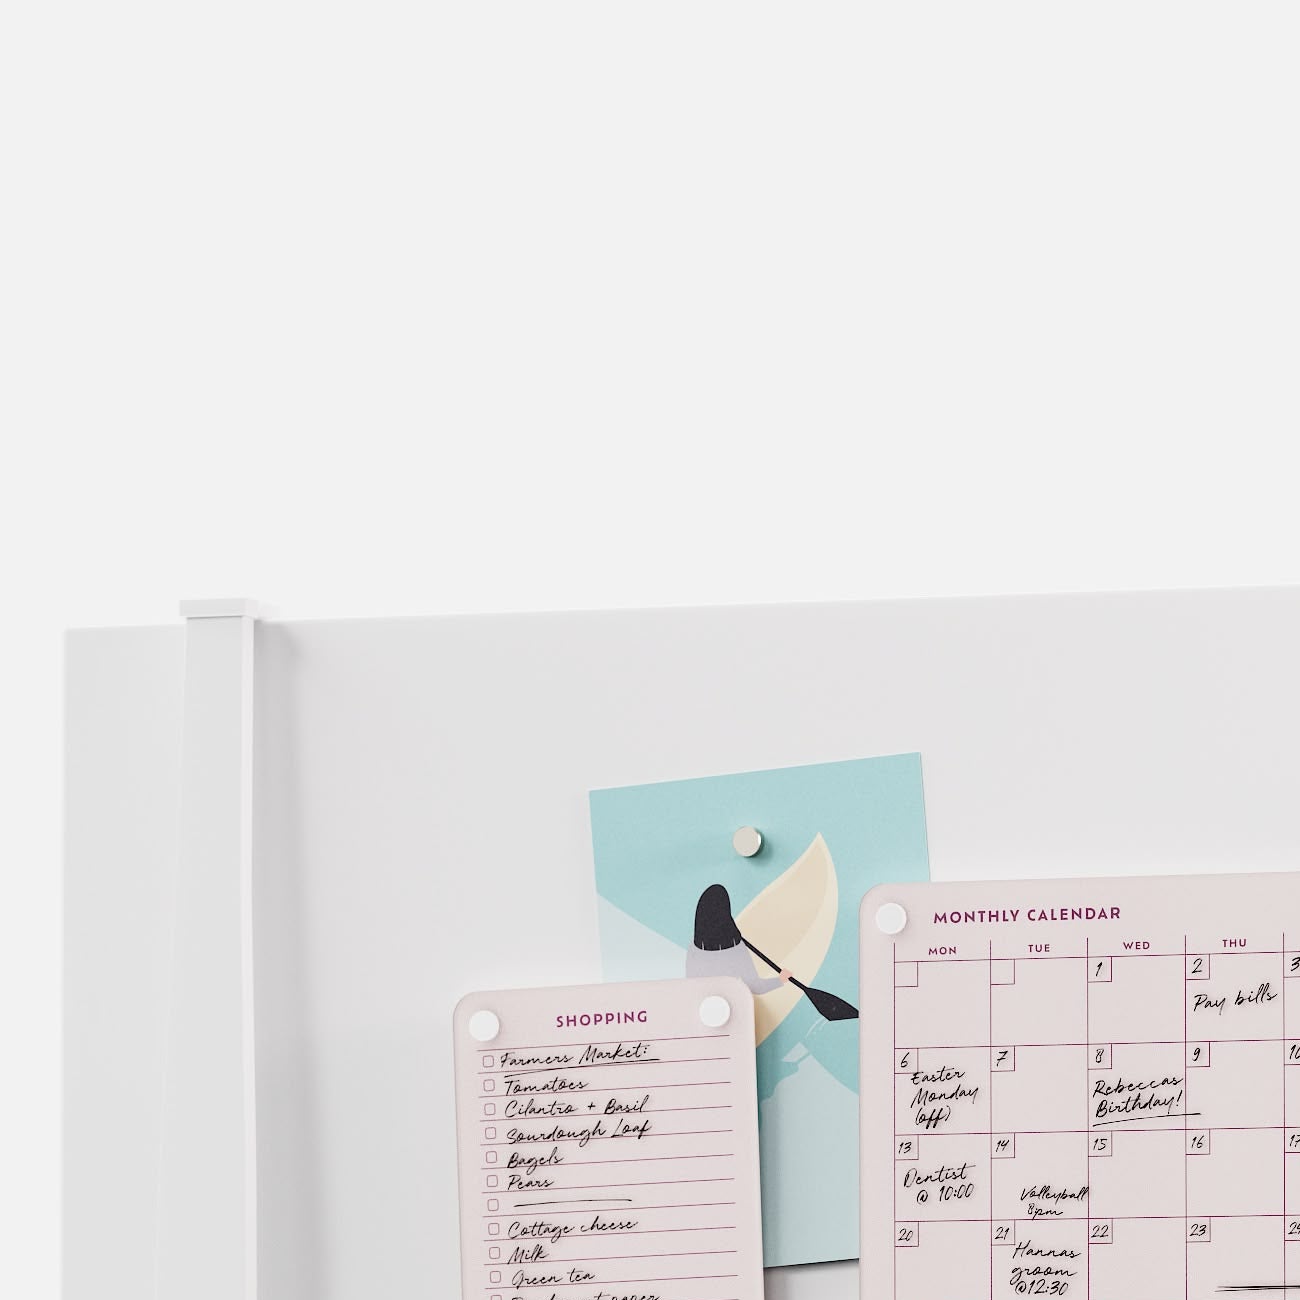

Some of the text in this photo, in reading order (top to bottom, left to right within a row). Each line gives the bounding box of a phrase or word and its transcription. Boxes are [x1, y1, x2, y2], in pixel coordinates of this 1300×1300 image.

[933, 907, 1121, 924] MONTHLY CALENDAR
[928, 946, 957, 956] MON
[1028, 944, 1050, 953] TUE
[1123, 941, 1150, 950] WED
[1222, 938, 1247, 948] THU
[1096, 962, 1102, 977] 1
[1191, 958, 1203, 973] 2
[1291, 957, 1300, 971] 3
[1193, 983, 1278, 1015] Pay bills
[556, 1010, 648, 1028] SHOPPING
[500, 1043, 650, 1068] Farmers Market:
[900, 1052, 909, 1068] 6
[997, 1051, 1008, 1067] 7
[1095, 1048, 1104, 1063] 8
[1192, 1047, 1201, 1061] 9
[911, 1066, 965, 1085] Easter
[504, 1077, 588, 1095] Tomatoes
[1093, 1076, 1183, 1099] Rebeccas
[911, 1084, 979, 1108] Monday
[1096, 1090, 1183, 1118] Birthday!
[504, 1100, 579, 1118] Cilantro
[604, 1095, 650, 1114] Basil
[915, 1106, 951, 1129] (off)
[506, 1118, 651, 1147] Sourdough Loaf
[898, 1142, 912, 1154] 13
[995, 1139, 1009, 1152] 14
[1093, 1139, 1107, 1151] 15
[1191, 1135, 1203, 1149] 16
[507, 1147, 564, 1175] Bagels
[508, 1175, 555, 1190] Pears
[903, 1163, 976, 1187] Dentist
[916, 1184, 974, 1204] @ 10:00
[1020, 1186, 1089, 1206] Volleyball
[1027, 1203, 1064, 1220] 8pm
[507, 1216, 639, 1243] Cottage cheese
[898, 1228, 913, 1241] 20
[995, 1227, 1009, 1240] 21
[1091, 1225, 1109, 1238] 22
[1190, 1224, 1207, 1236] 23
[508, 1244, 550, 1264] Milk
[1012, 1240, 1081, 1259] Hannas
[511, 1268, 596, 1288] Green tea
[1010, 1266, 1077, 1285] groom
[1015, 1279, 1069, 1295] @12:30
